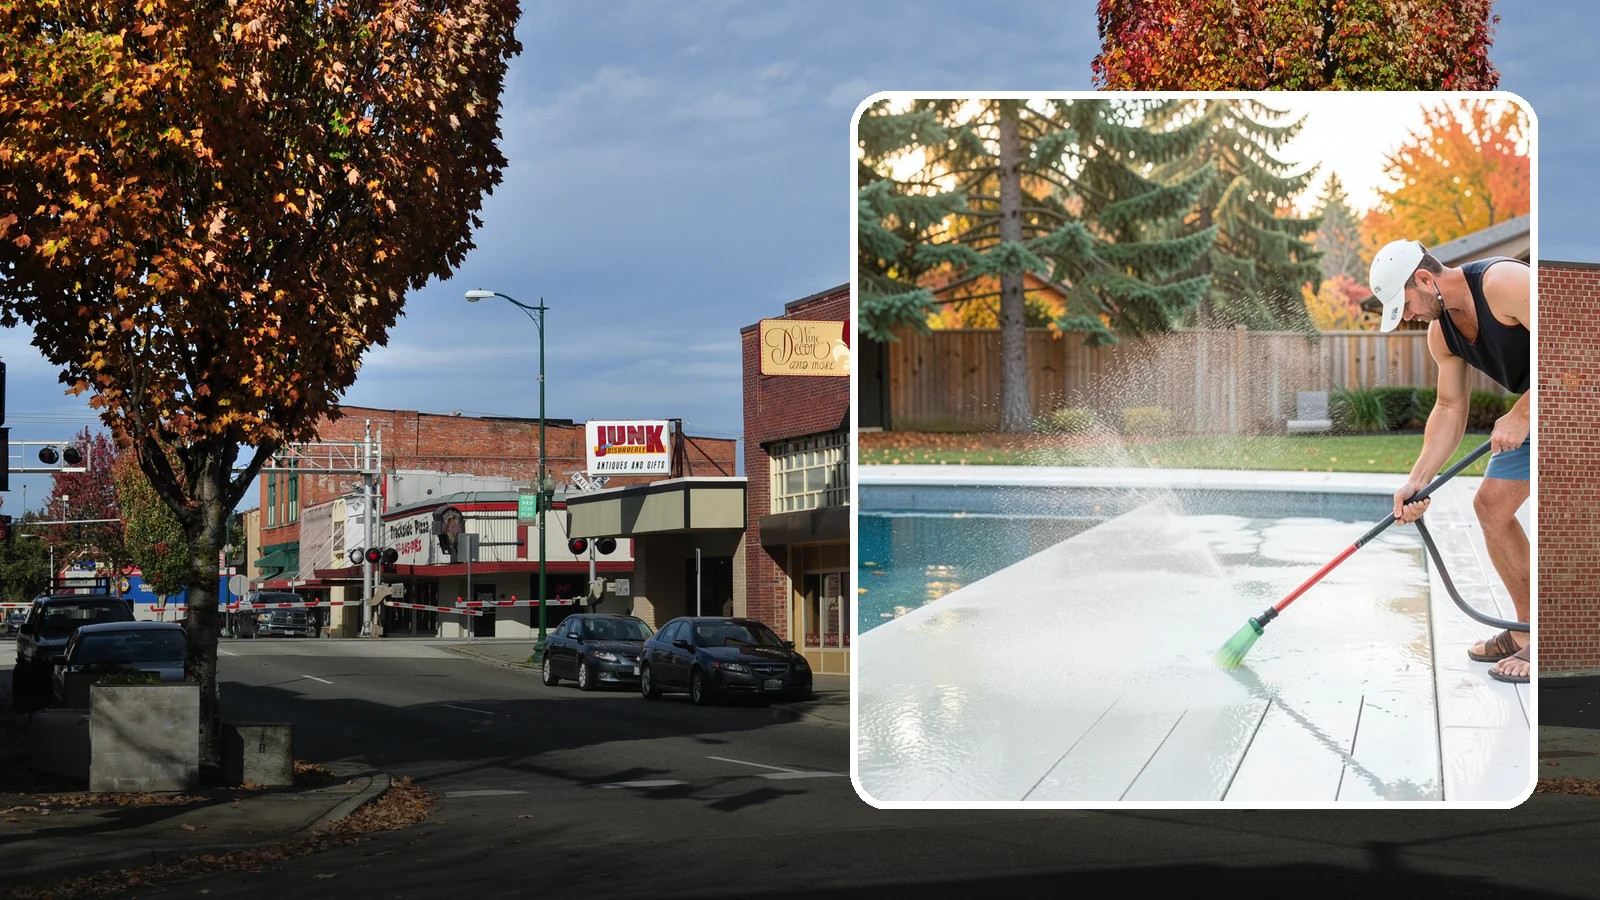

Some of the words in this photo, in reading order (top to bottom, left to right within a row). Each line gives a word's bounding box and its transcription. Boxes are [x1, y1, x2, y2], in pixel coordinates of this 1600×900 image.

[596, 425, 666, 457] JUNK
[607, 446, 646, 454] DISORDERLY
[597, 461, 628, 470] ANTIQUES
[631, 461, 644, 470] AND
[647, 460, 666, 469] GIFTS
[390, 522, 413, 540] Trackside
[414, 519, 429, 535] Pizza
